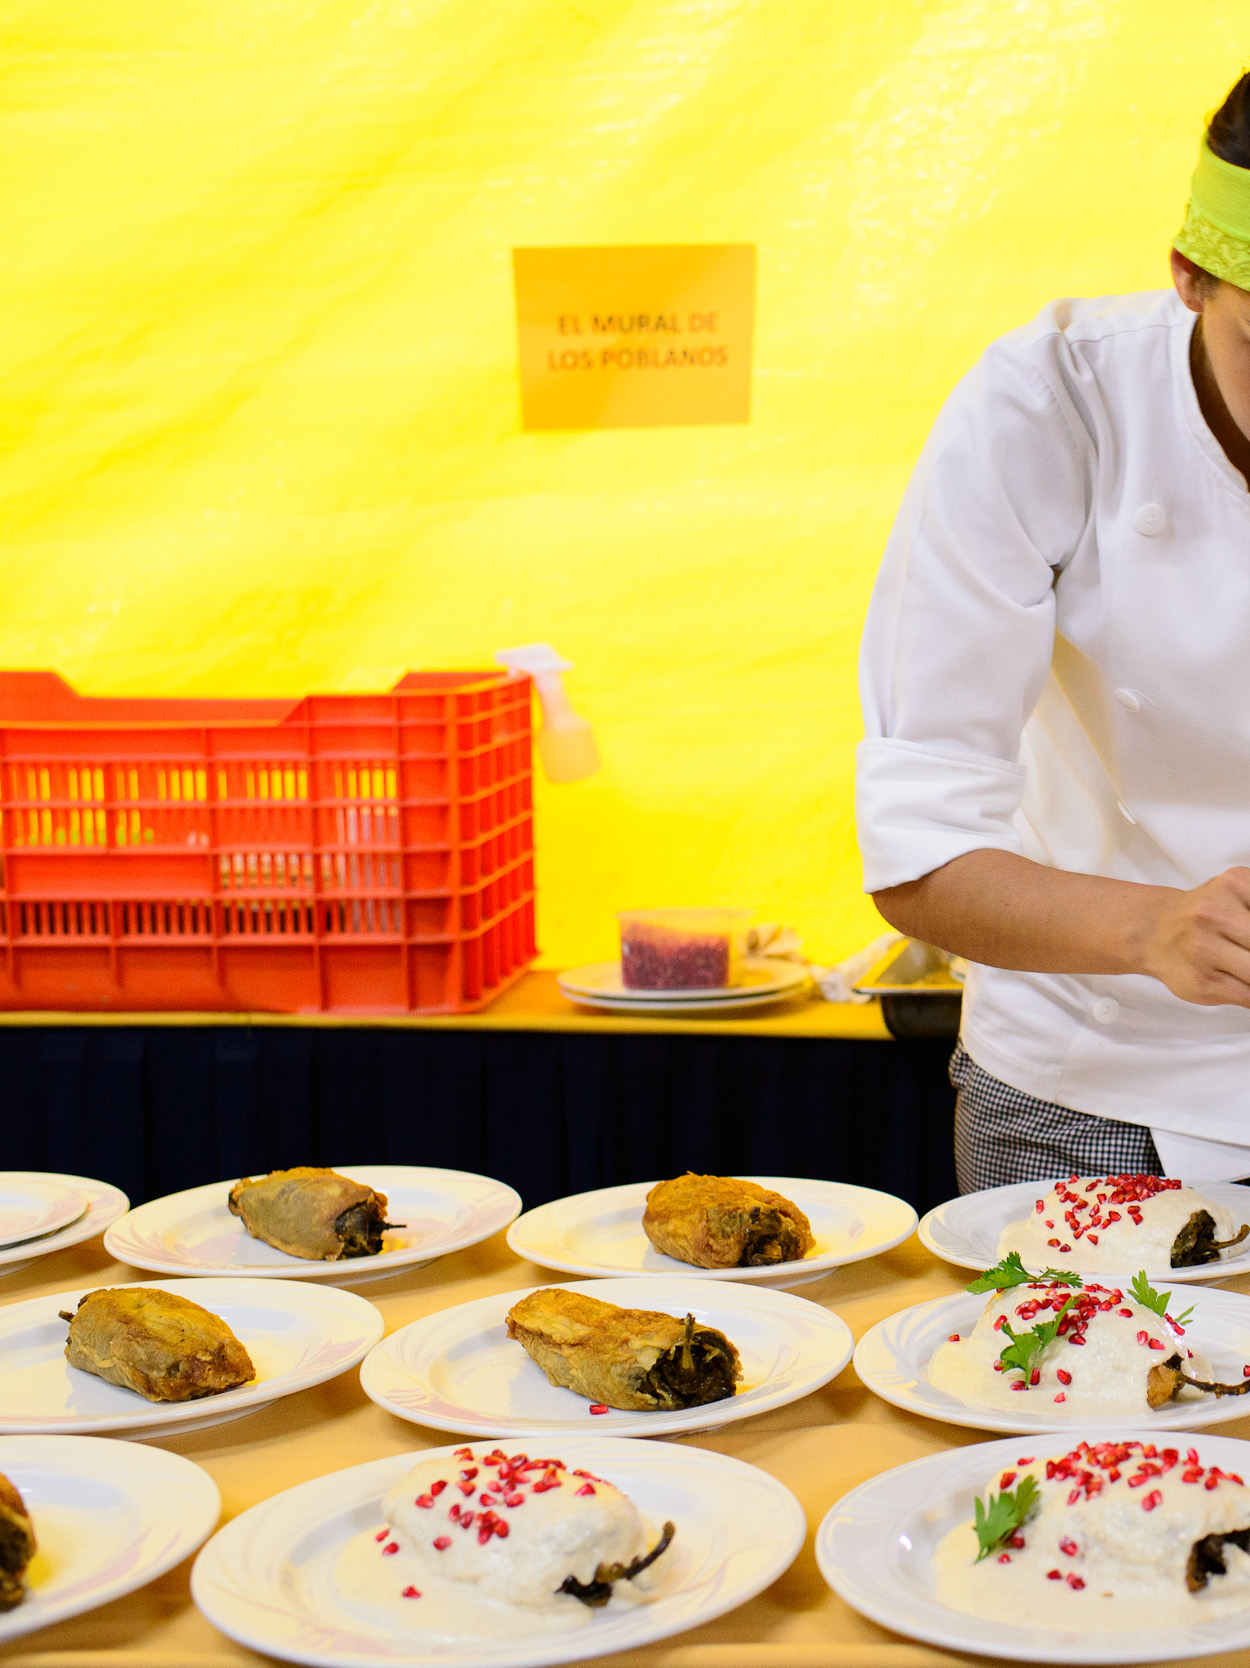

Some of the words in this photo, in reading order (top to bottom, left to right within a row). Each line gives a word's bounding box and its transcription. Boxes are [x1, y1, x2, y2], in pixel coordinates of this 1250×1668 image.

[558, 314, 582, 335] EL
[592, 313, 681, 334] MURAL
[689, 311, 718, 333] DE
[548, 349, 594, 371] LOS
[601, 345, 729, 370] POBLANOS
